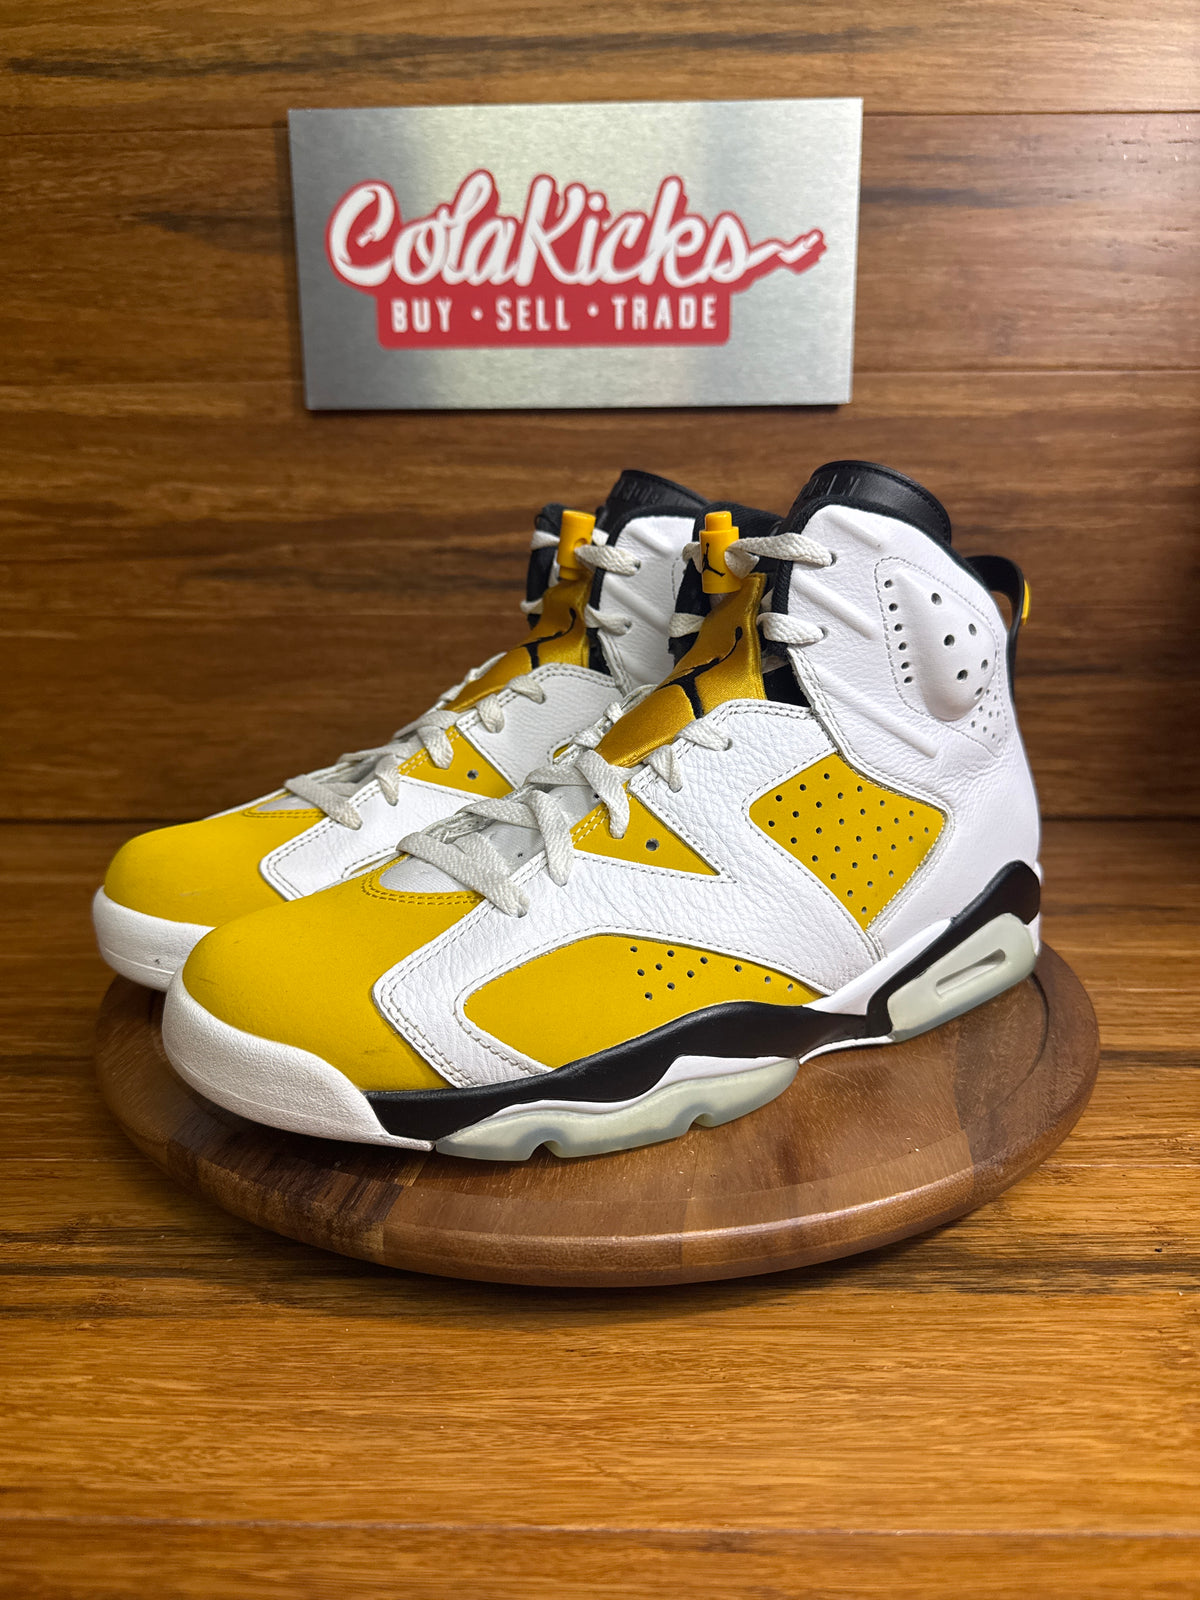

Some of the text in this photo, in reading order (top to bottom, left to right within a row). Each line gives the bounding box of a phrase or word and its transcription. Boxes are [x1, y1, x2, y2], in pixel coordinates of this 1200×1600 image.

[328, 173, 822, 288] ColaKicks
[391, 293, 717, 333] BUY SELL TRADE
